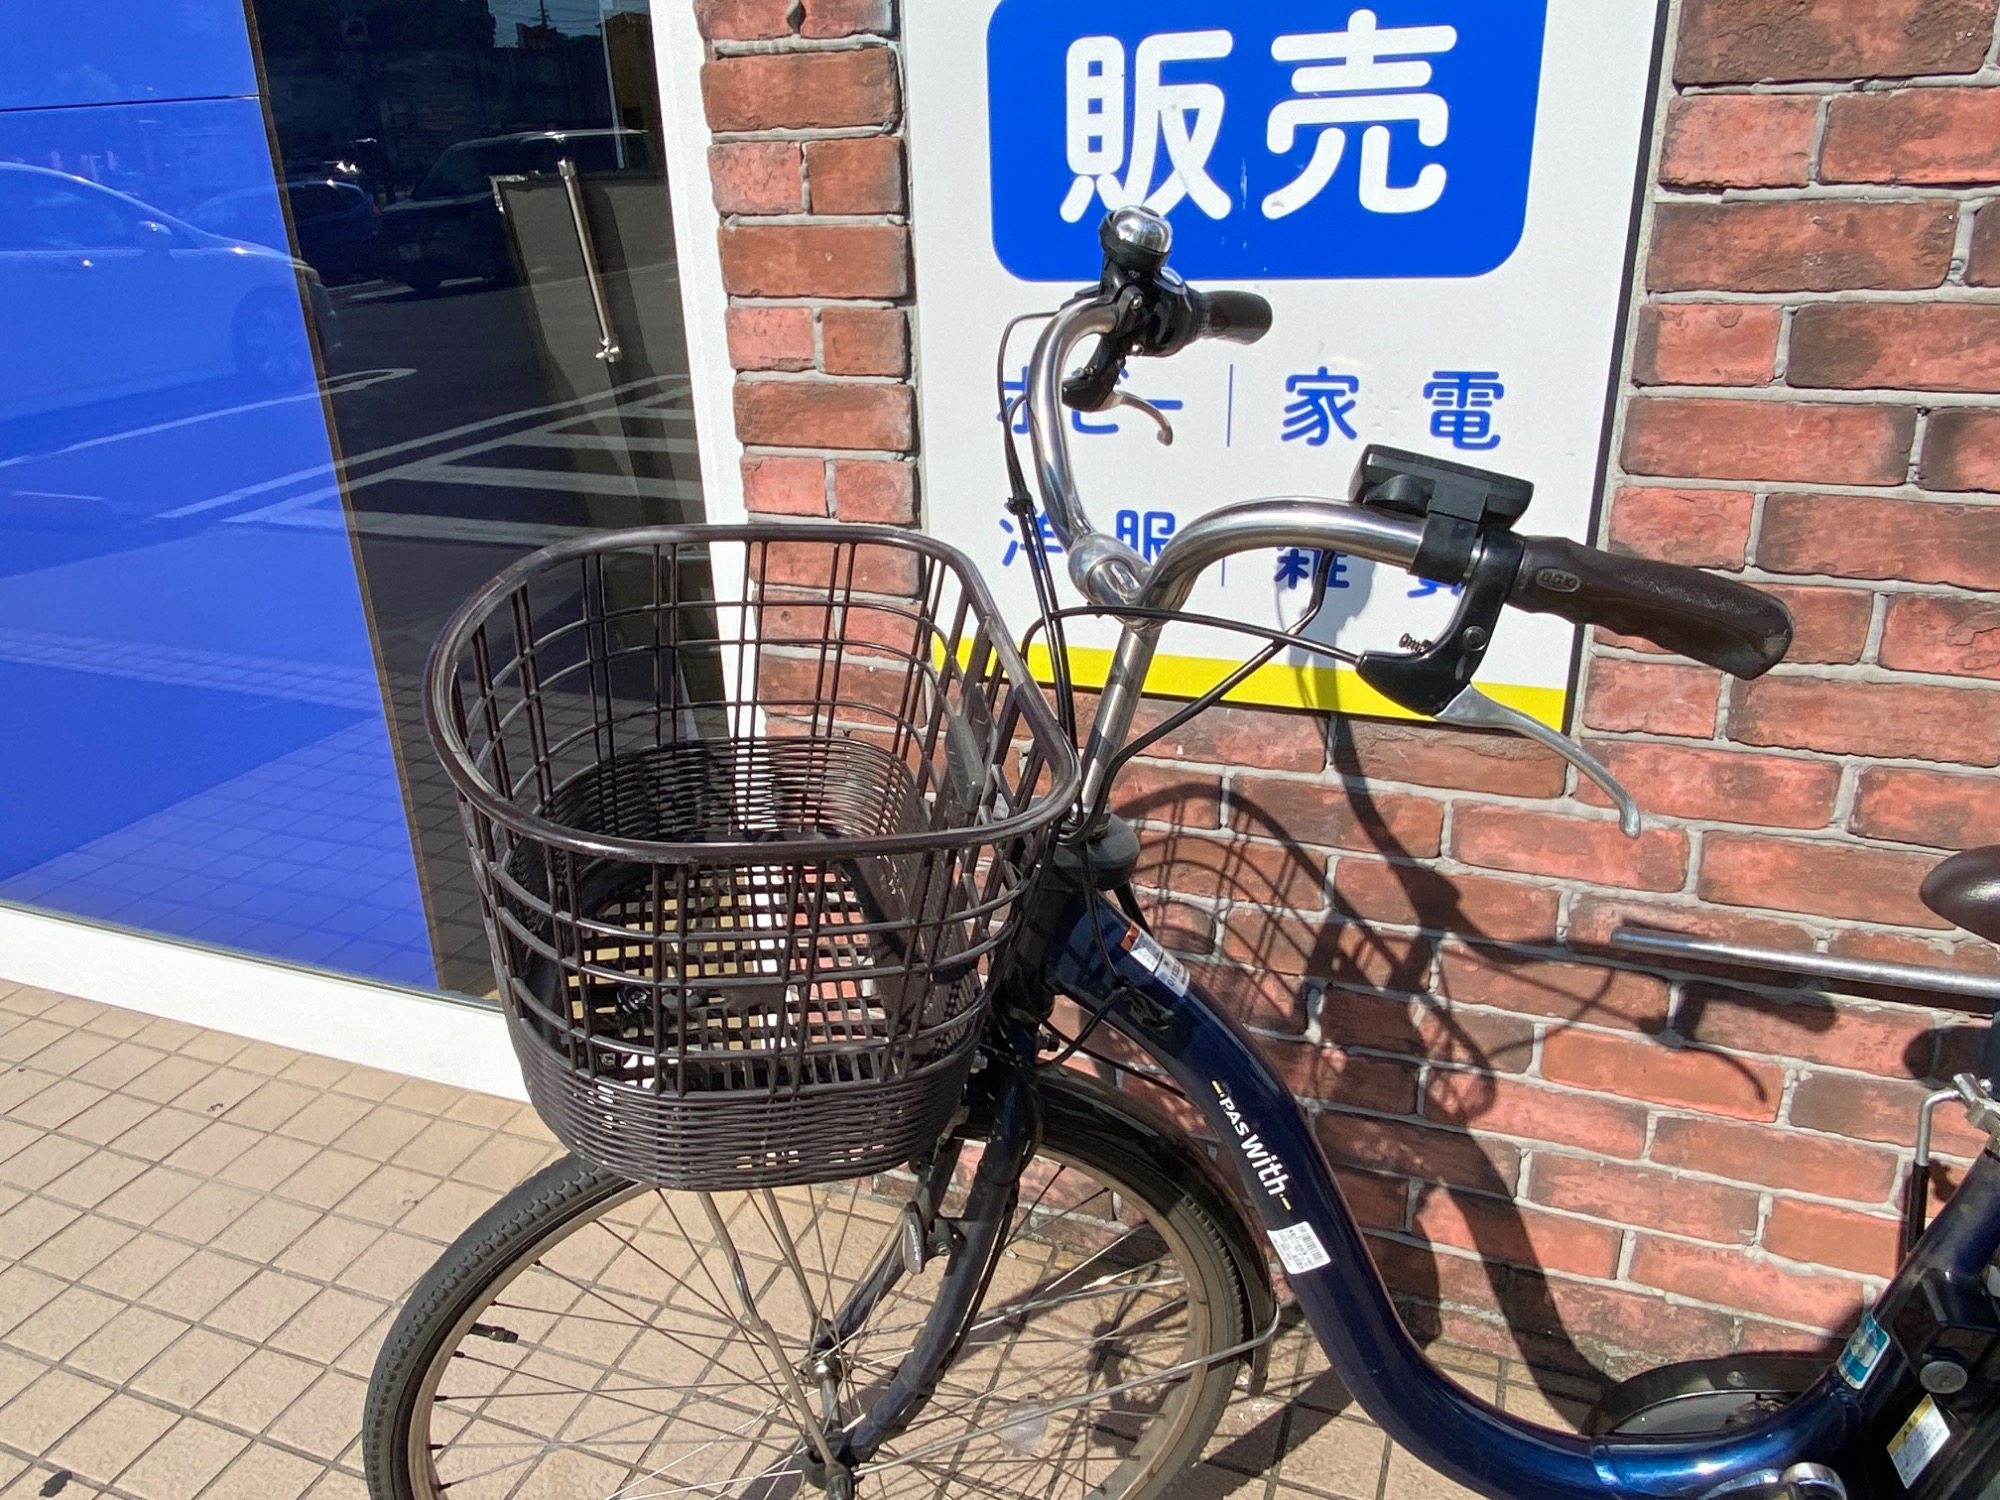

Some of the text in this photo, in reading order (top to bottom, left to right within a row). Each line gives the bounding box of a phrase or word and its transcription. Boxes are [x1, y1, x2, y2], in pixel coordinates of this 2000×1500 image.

[1060, 9, 1458, 223] 販売
[1280, 366, 1505, 450] 家電
[1219, 1096, 1291, 1196] PAS With
